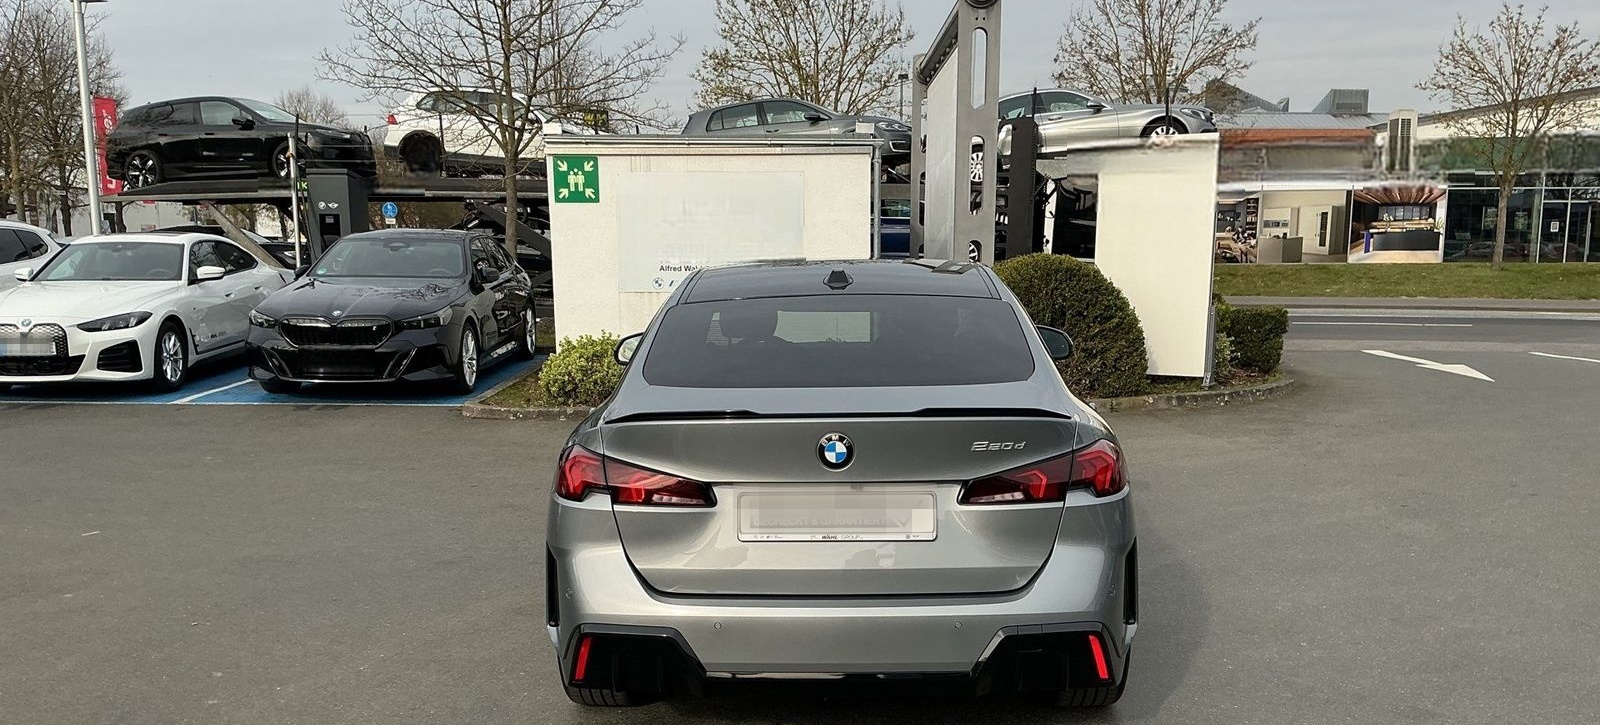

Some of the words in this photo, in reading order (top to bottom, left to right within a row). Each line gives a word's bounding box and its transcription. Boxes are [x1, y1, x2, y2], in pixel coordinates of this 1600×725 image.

[820, 434, 851, 447] BMW
[970, 441, 1026, 451] 220d
[753, 515, 809, 526] GECHECKT
[811, 515, 819, 526] &
[821, 515, 886, 526] GARANTIERT
